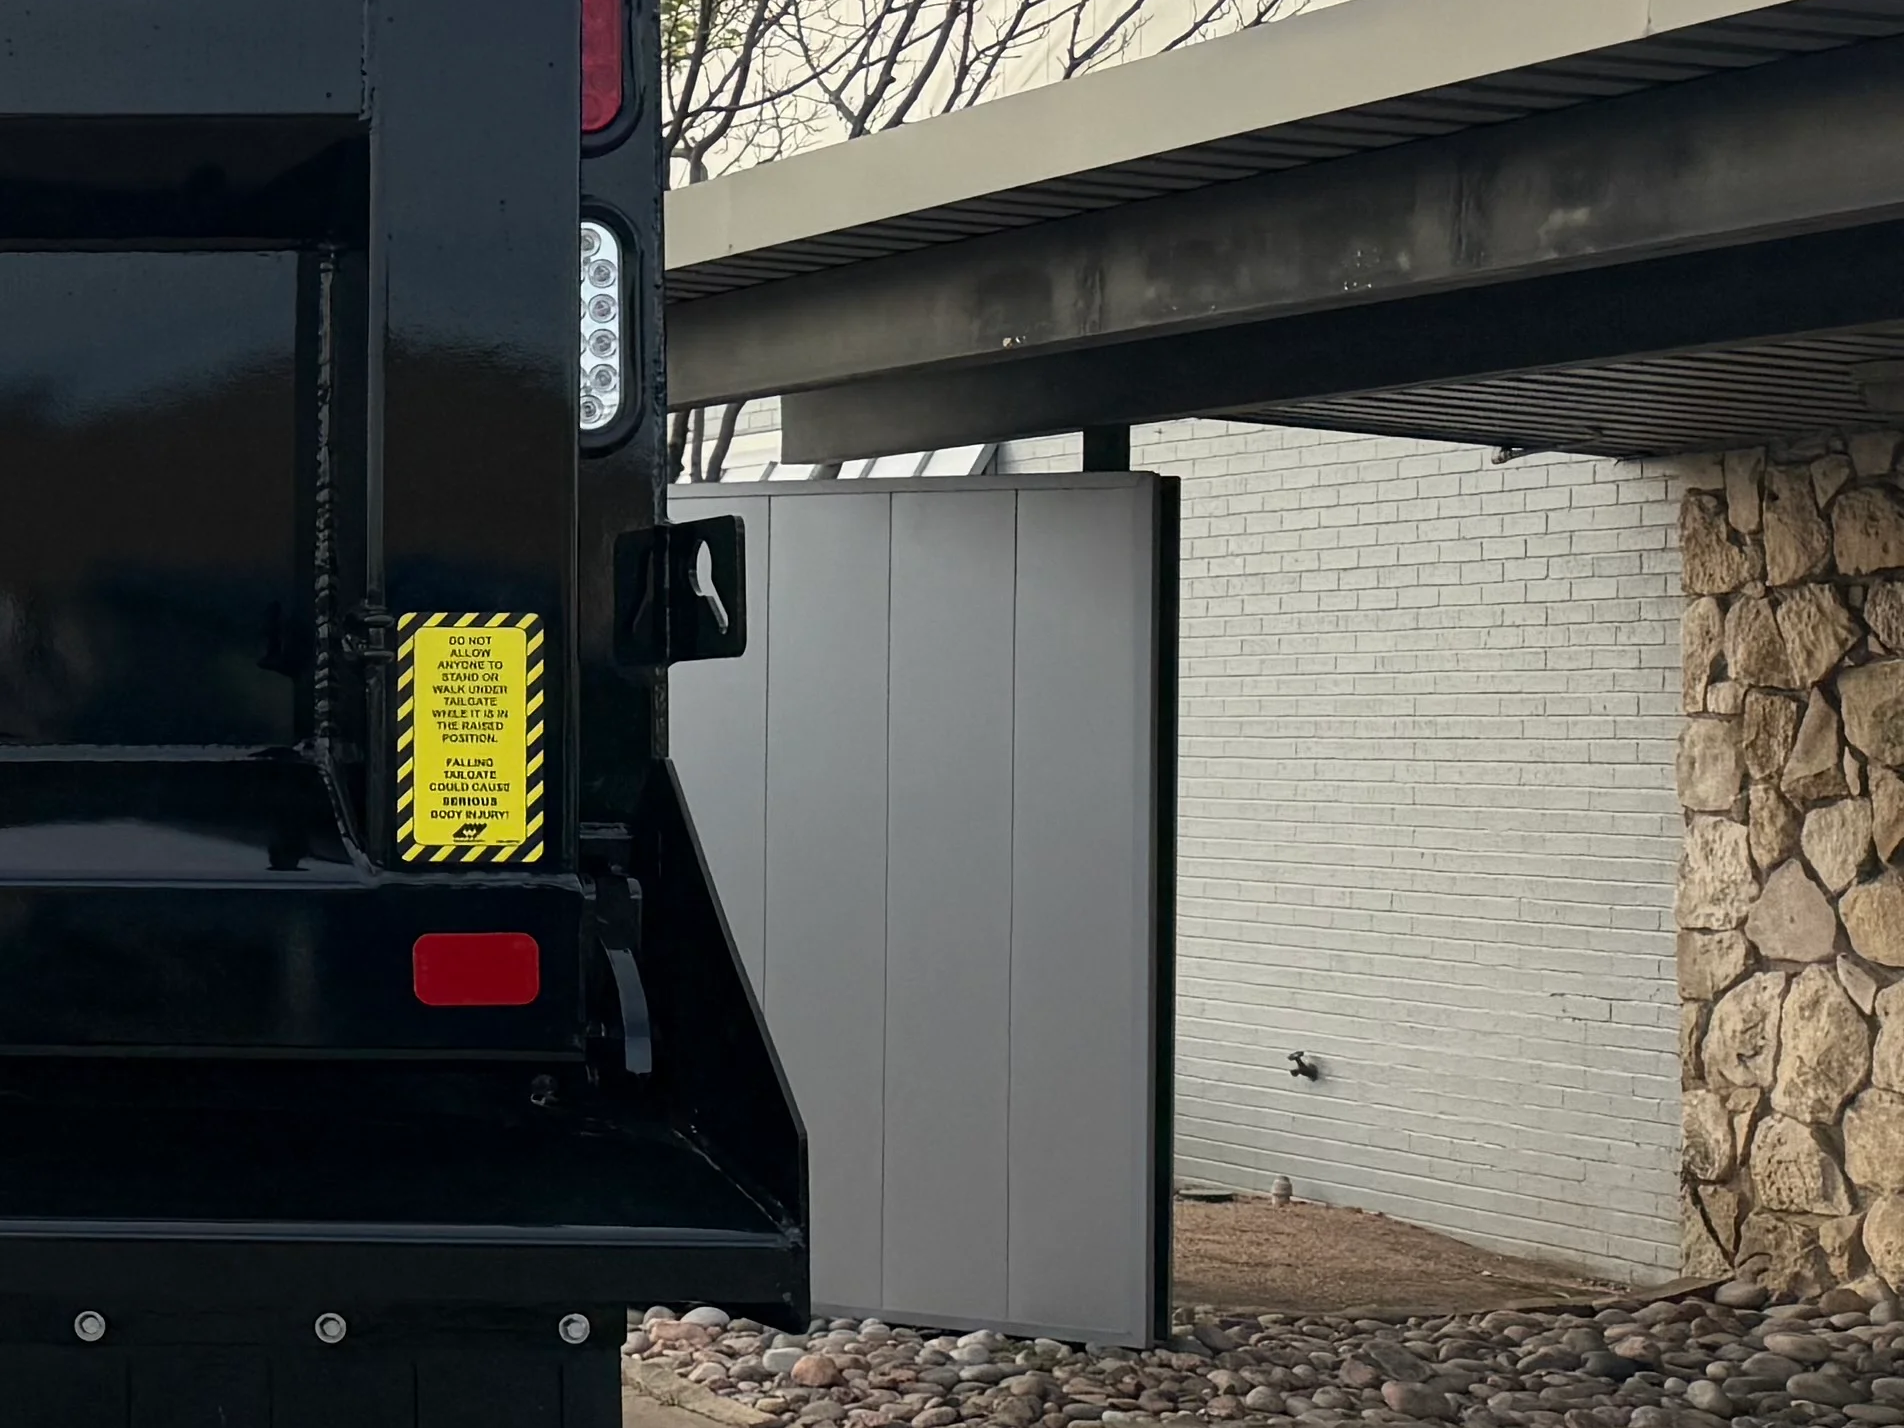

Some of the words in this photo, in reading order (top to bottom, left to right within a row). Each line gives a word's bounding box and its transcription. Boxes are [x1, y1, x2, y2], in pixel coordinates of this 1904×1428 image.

[448, 635, 466, 646] DO
[468, 635, 492, 646] NOT
[449, 648, 492, 658] ALLOW
[437, 660, 485, 671] ANYONE
[487, 660, 504, 671] TO
[441, 672, 479, 682] STAND
[481, 672, 499, 682] OR
[432, 684, 465, 695] WALK
[468, 684, 508, 695] UNDER
[443, 696, 498, 707] TAILGATE
[431, 708, 468, 719] WHILE
[470, 708, 481, 719] IT
[483, 708, 495, 719] IS
[496, 708, 509, 719] IN
[436, 720, 459, 732] THE
[461, 720, 504, 732] RAISED
[445, 757, 494, 768] FALLING
[443, 770, 497, 780] TAILGATE
[428, 781, 469, 793] COULD
[442, 796, 498, 807] SERIOUS
[429, 809, 463, 821] BODY
